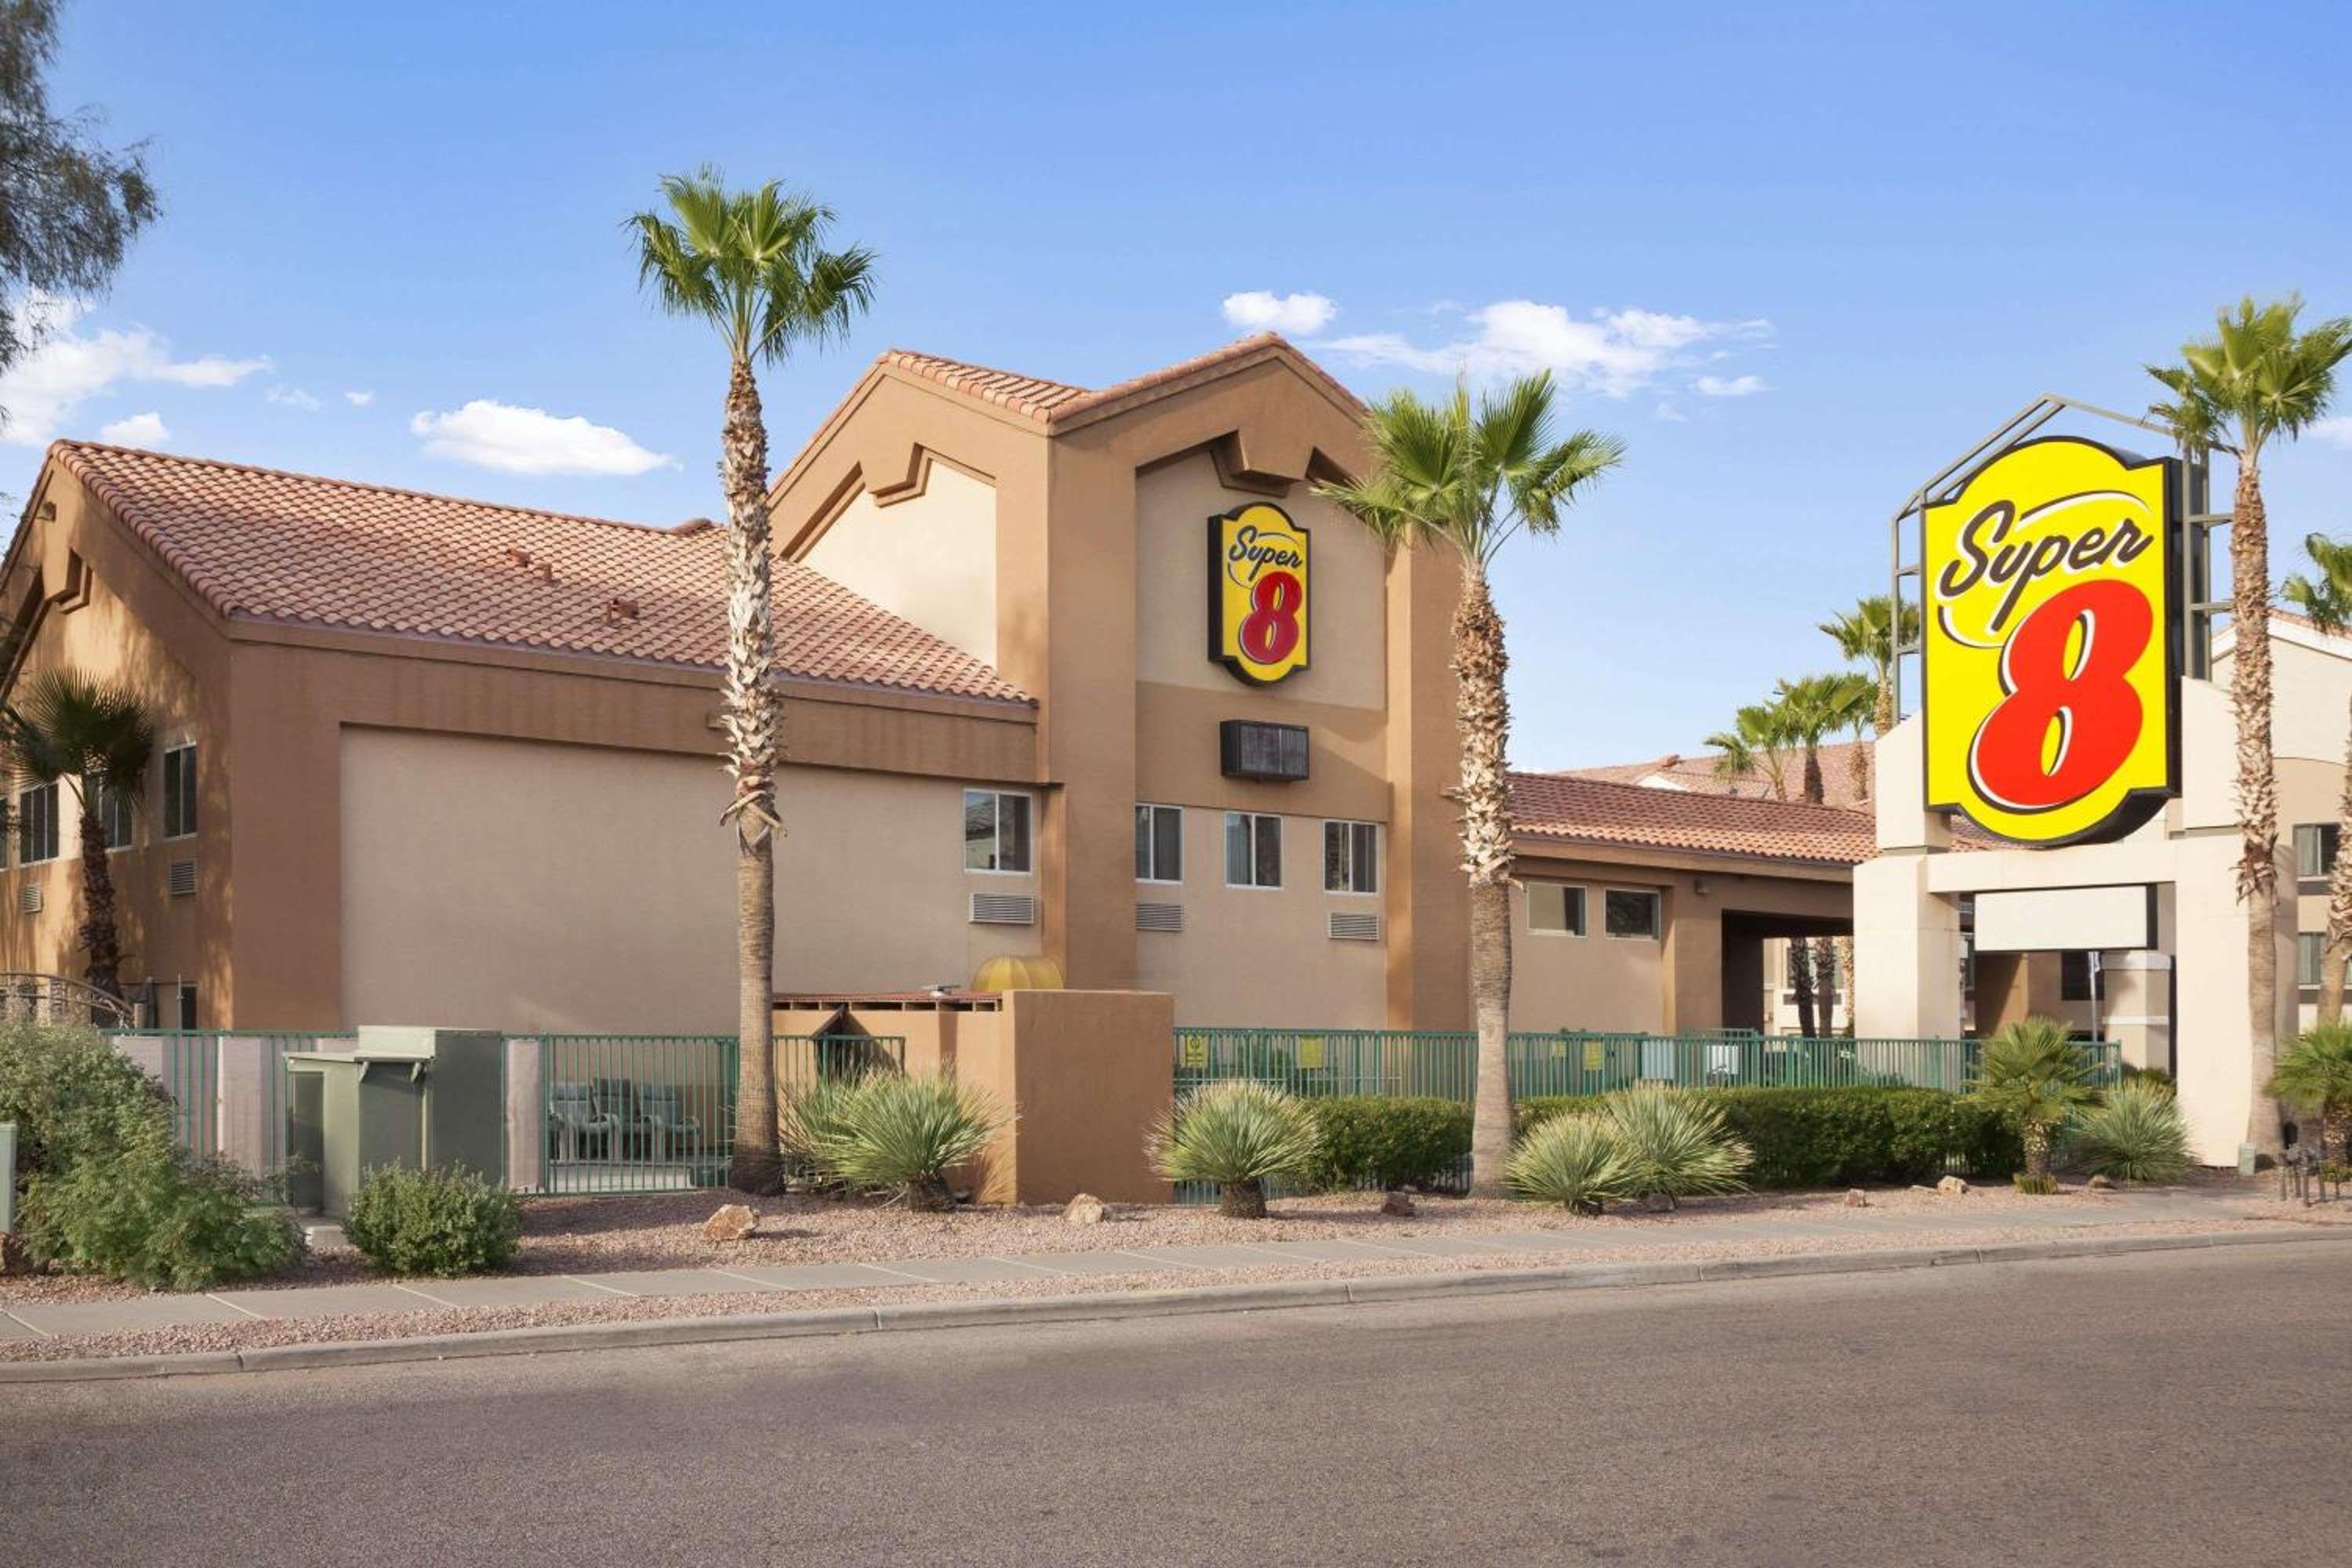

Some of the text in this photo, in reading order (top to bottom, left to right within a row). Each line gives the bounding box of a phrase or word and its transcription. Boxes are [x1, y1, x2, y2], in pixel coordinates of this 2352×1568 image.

[1229, 524, 1302, 581] Super
[1938, 500, 2154, 633] Super
[1240, 571, 1302, 664] 8
[1966, 579, 2154, 815] 8
